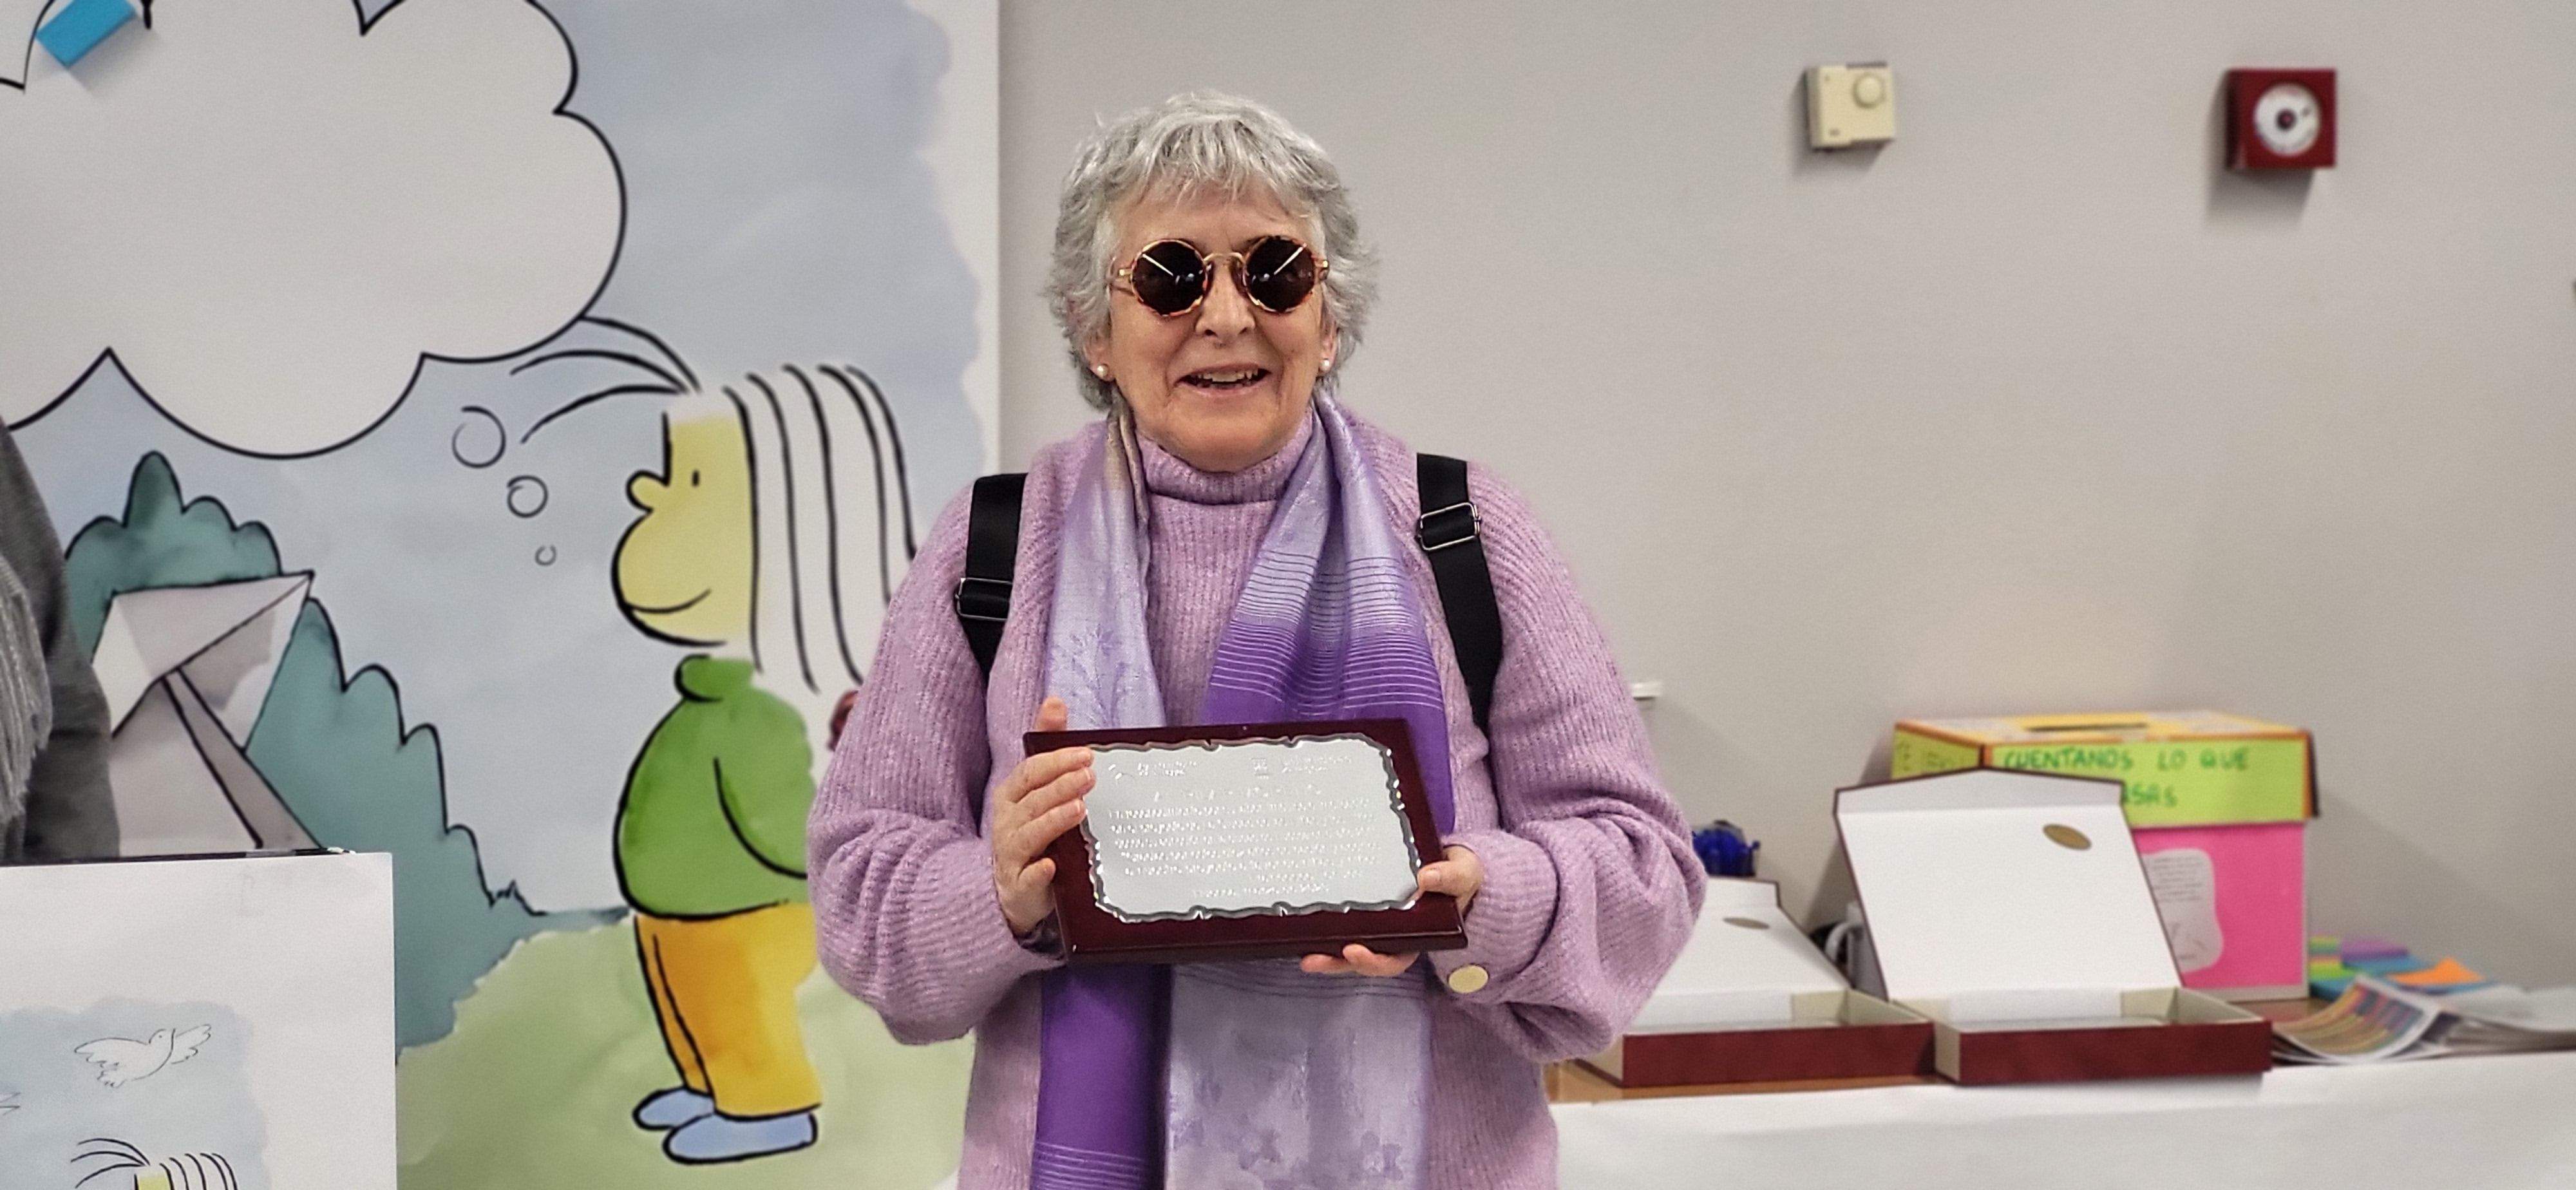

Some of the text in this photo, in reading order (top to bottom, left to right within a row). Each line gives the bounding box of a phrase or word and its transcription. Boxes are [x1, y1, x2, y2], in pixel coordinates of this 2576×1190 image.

[2157, 749, 2186, 770] LO
[2199, 747, 2248, 770] QUE
[2124, 782, 2177, 807] SAS
